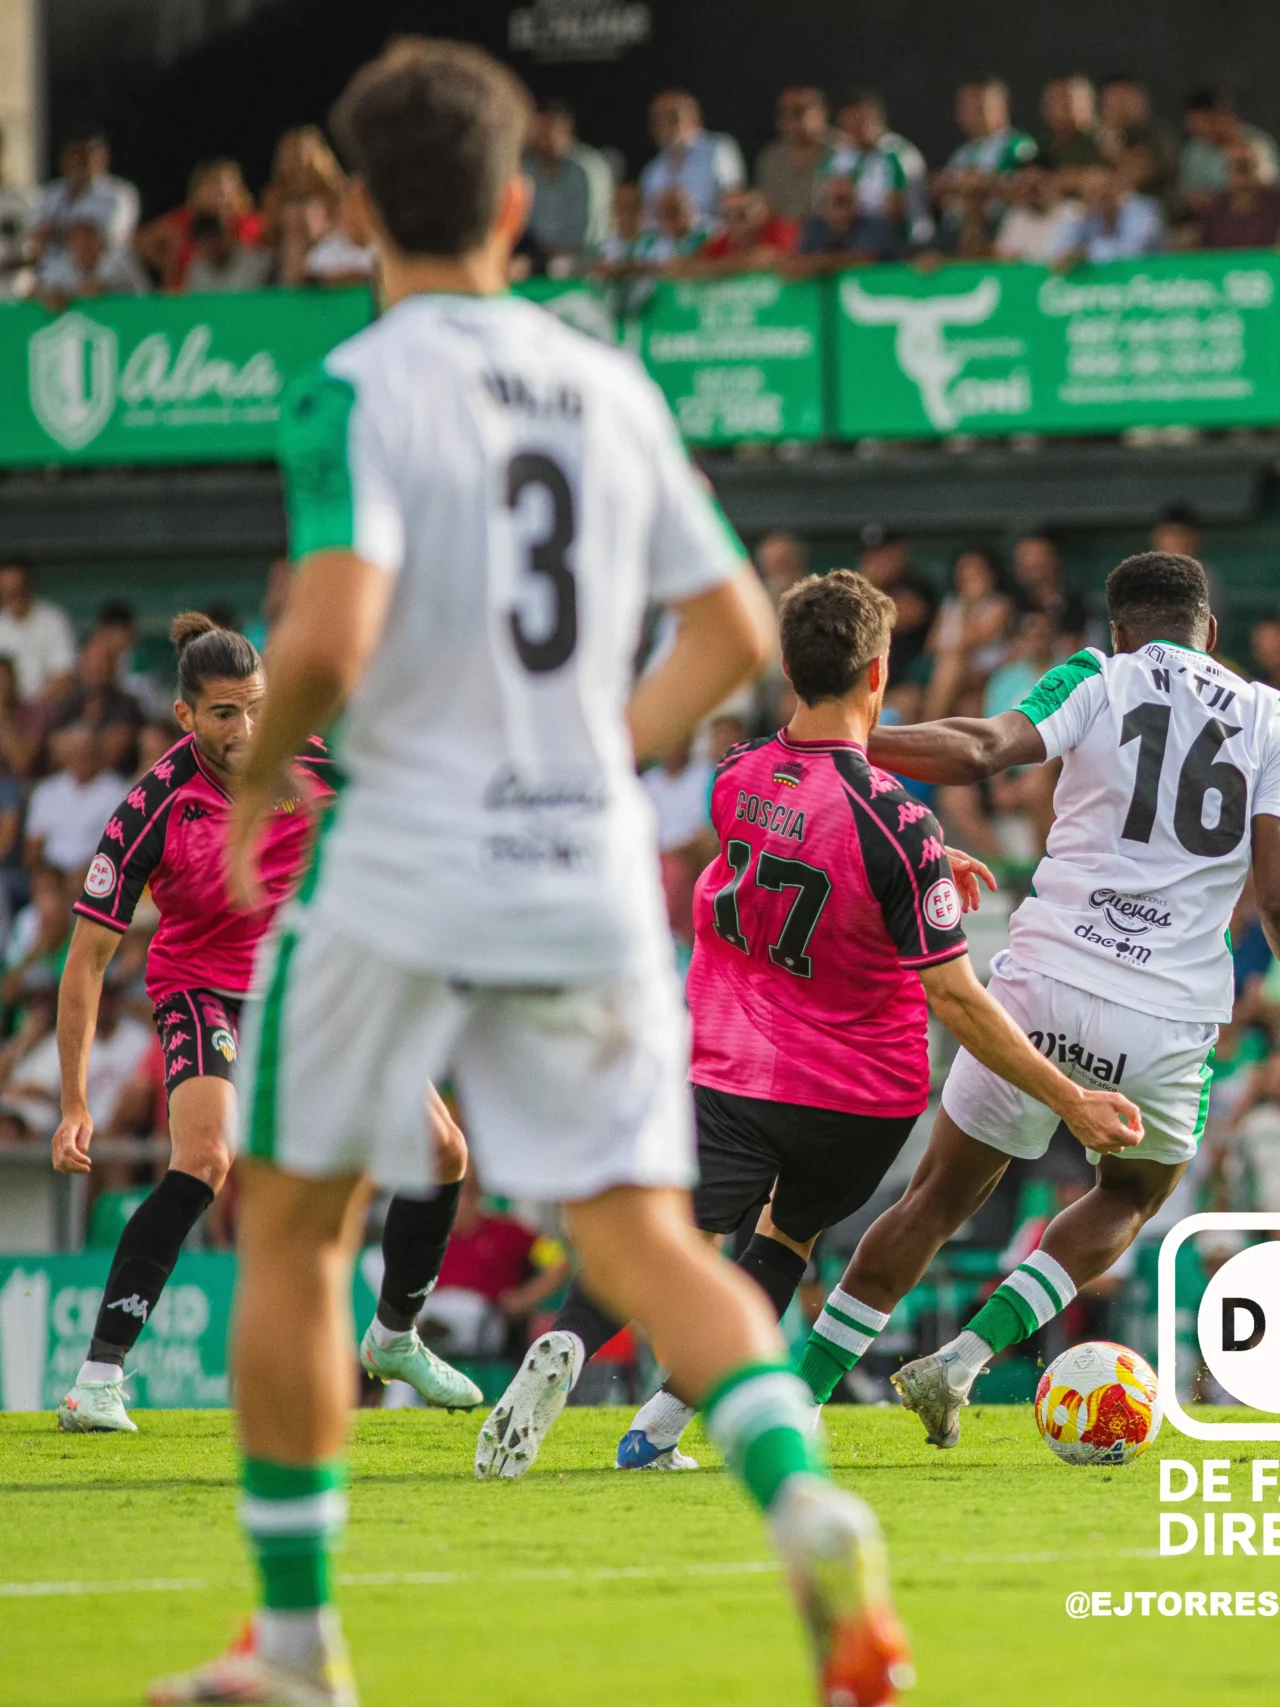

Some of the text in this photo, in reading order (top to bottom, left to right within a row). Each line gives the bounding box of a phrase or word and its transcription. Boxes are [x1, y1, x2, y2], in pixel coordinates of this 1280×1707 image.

[505, 452, 577, 672] 3
[736, 789, 806, 843] COSCIA
[1118, 701, 1248, 858] 16
[712, 839, 833, 979] 17
[1088, 888, 1173, 929] Cuevas
